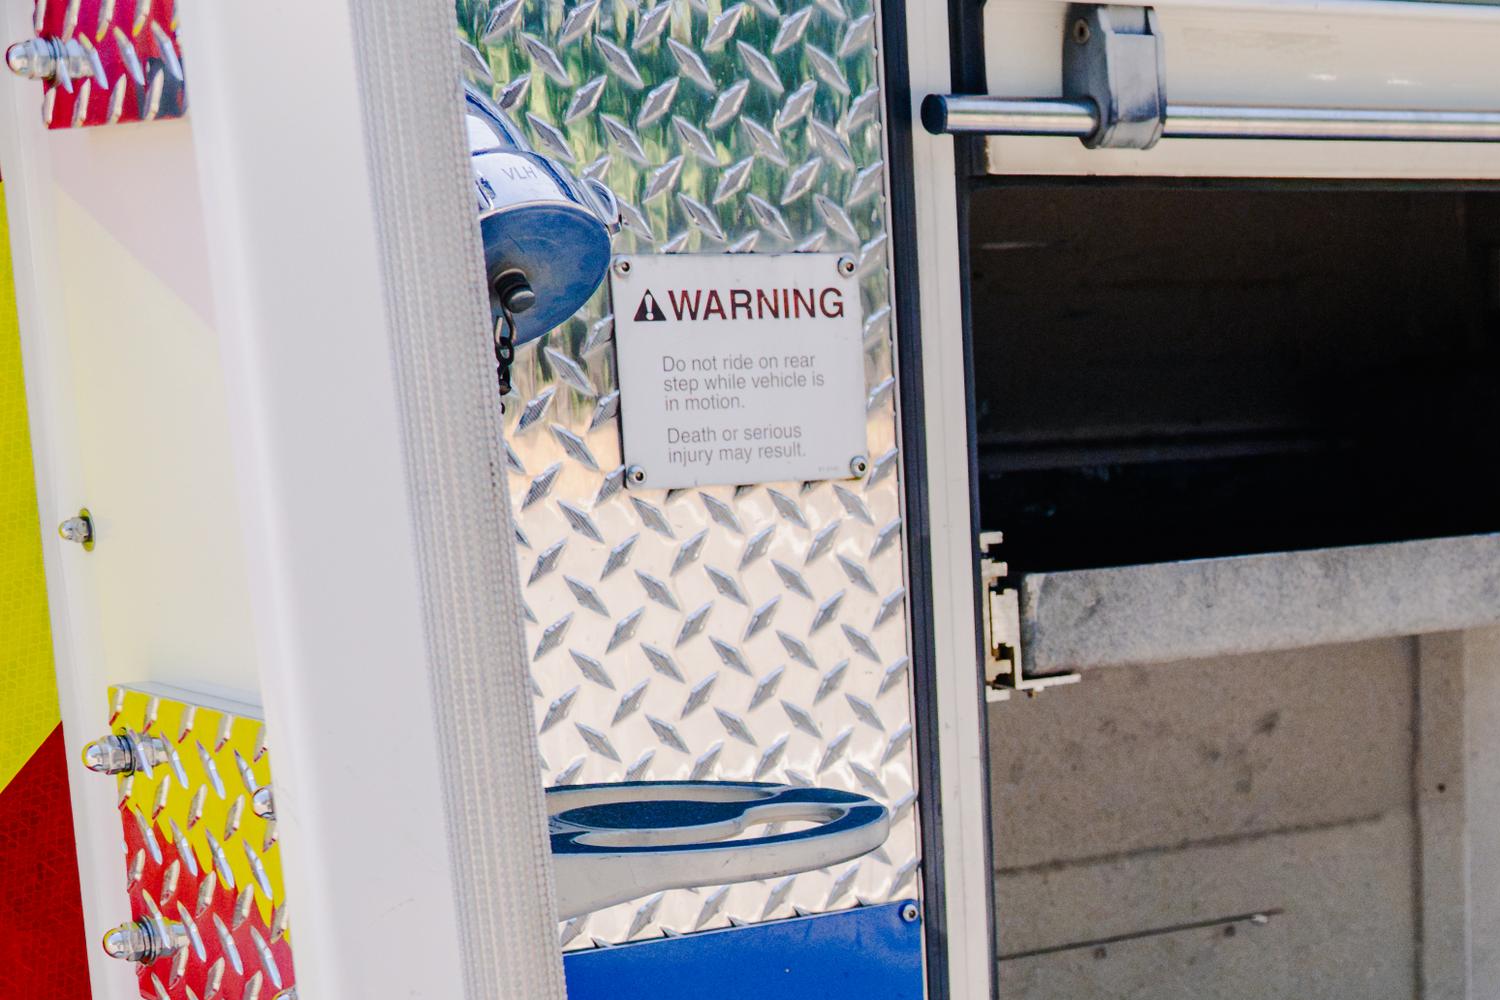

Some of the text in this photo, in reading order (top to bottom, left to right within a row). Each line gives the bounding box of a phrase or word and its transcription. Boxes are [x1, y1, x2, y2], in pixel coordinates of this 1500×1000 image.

[668, 288, 844, 321] WARNING
[663, 354, 815, 372] Do not ride on rear
[664, 372, 824, 394] step while vehicle is
[665, 395, 745, 411] in motion.
[668, 425, 801, 443] Death or serious
[669, 444, 806, 465] injury may result.
